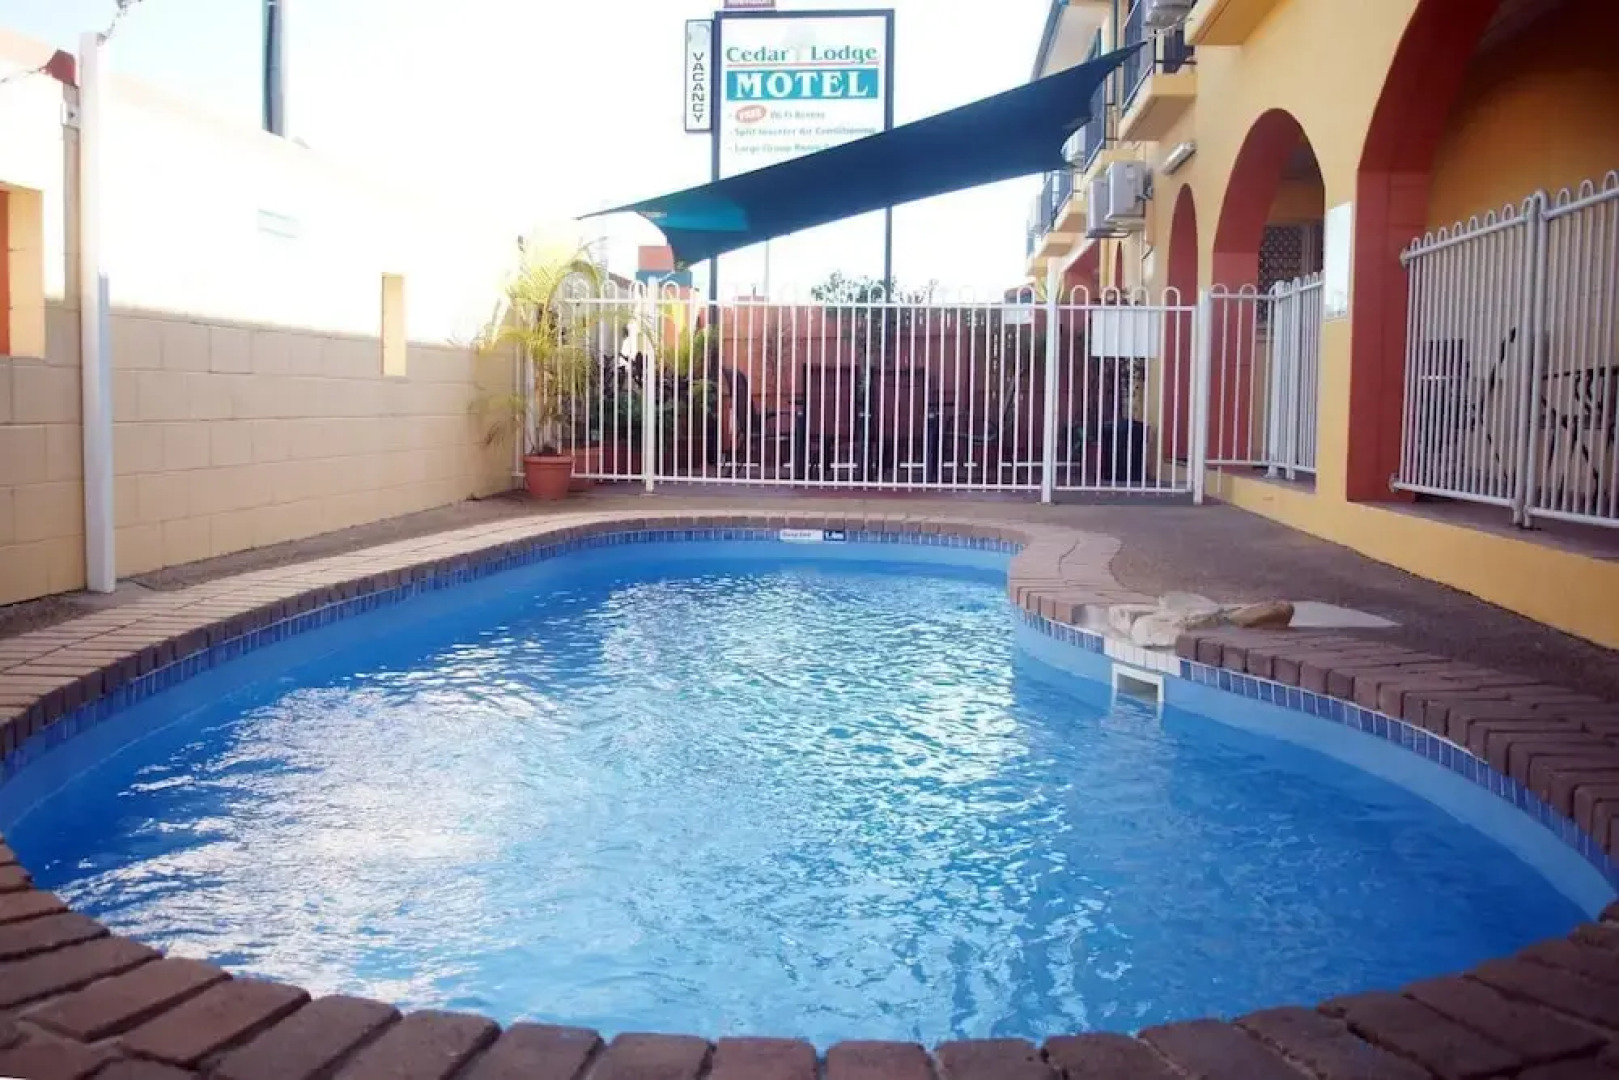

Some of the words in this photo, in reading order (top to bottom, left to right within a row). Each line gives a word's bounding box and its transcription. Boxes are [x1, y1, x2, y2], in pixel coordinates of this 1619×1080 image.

[726, 46, 789, 62] Cedar
[811, 45, 877, 63] Lodge
[692, 52, 705, 123] VACANCY
[735, 71, 868, 98] MOTEL
